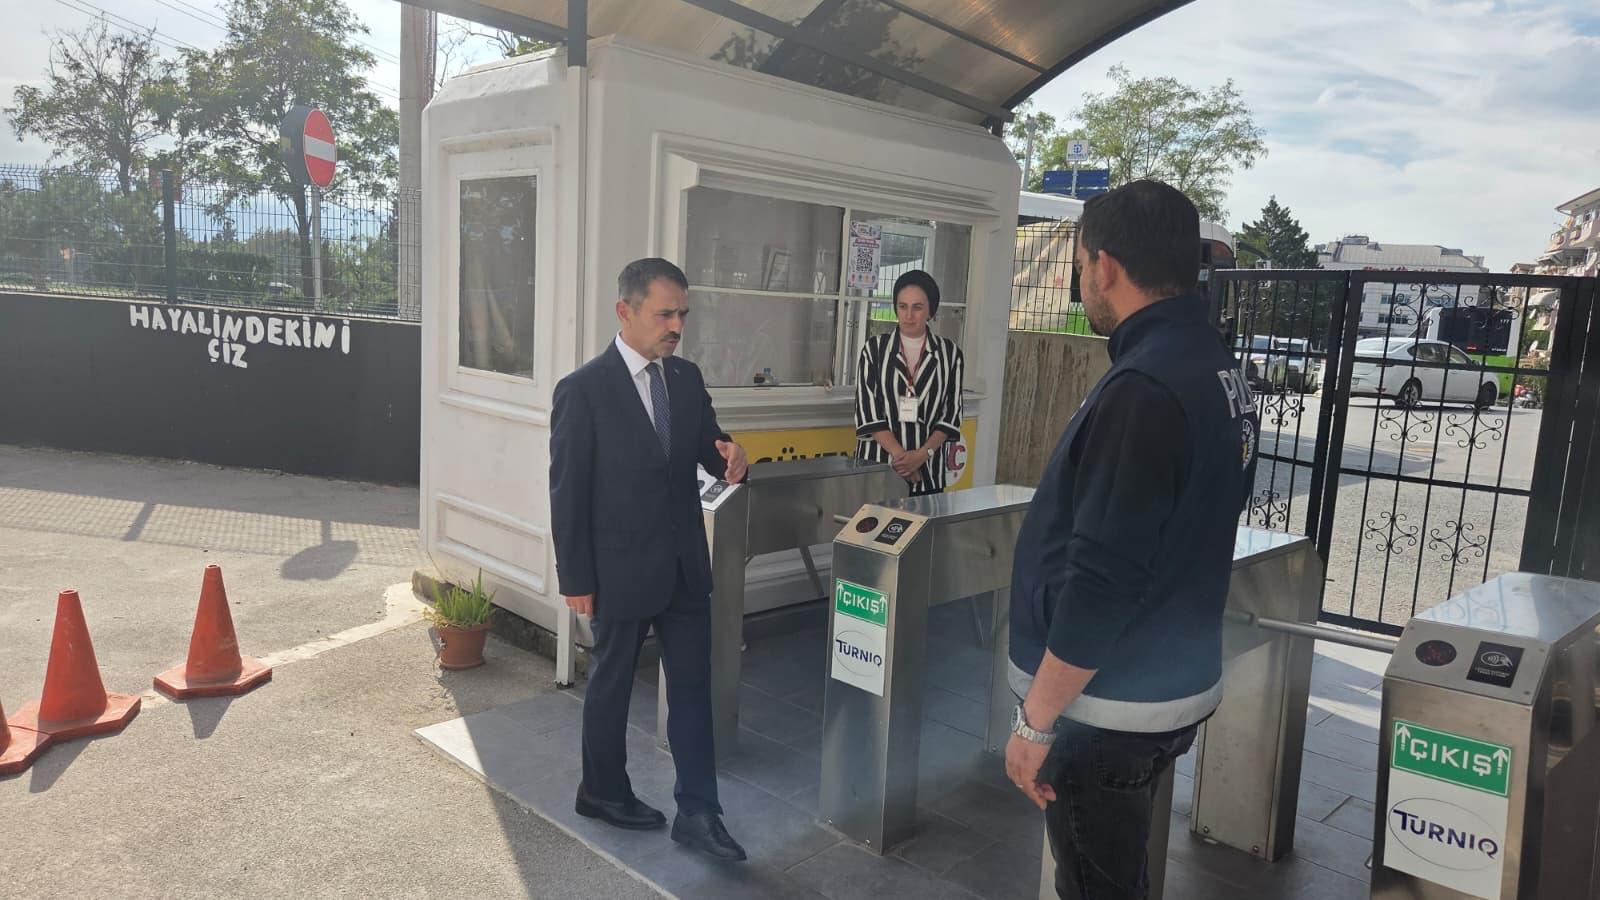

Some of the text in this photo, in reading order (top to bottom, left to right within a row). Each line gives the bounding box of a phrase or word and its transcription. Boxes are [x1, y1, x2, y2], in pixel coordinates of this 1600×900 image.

[208, 338, 248, 368] ÇİZ
[843, 591, 880, 615] ÇIKIŞ
[1410, 738, 1492, 776] ÇIKIŞ
